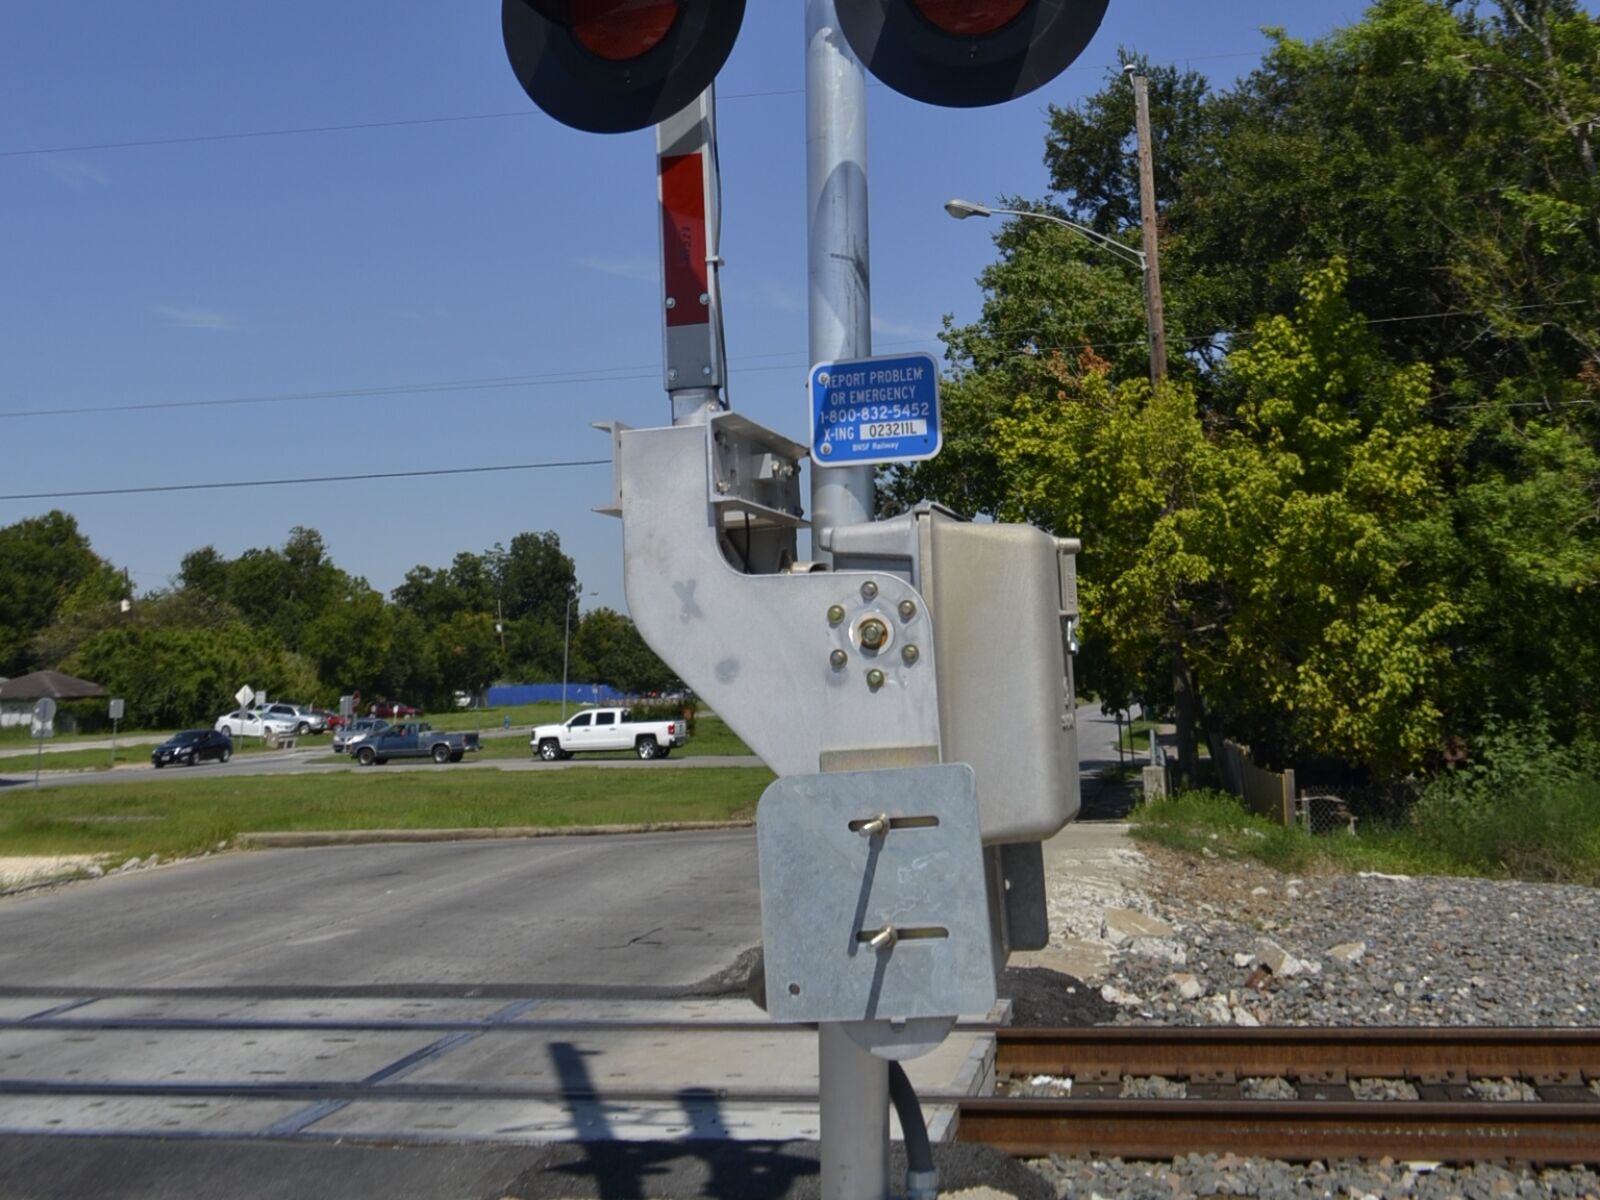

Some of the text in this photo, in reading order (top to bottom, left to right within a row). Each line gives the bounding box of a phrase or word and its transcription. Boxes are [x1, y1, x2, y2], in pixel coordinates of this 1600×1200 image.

[870, 368, 922, 384] PROBLEM
[831, 386, 916, 405] OR EMERGENCY
[820, 402, 929, 424] 1-800-832-5452
[824, 422, 917, 442] X-ING 023211L
[852, 441, 899, 452] BNSF Railway
